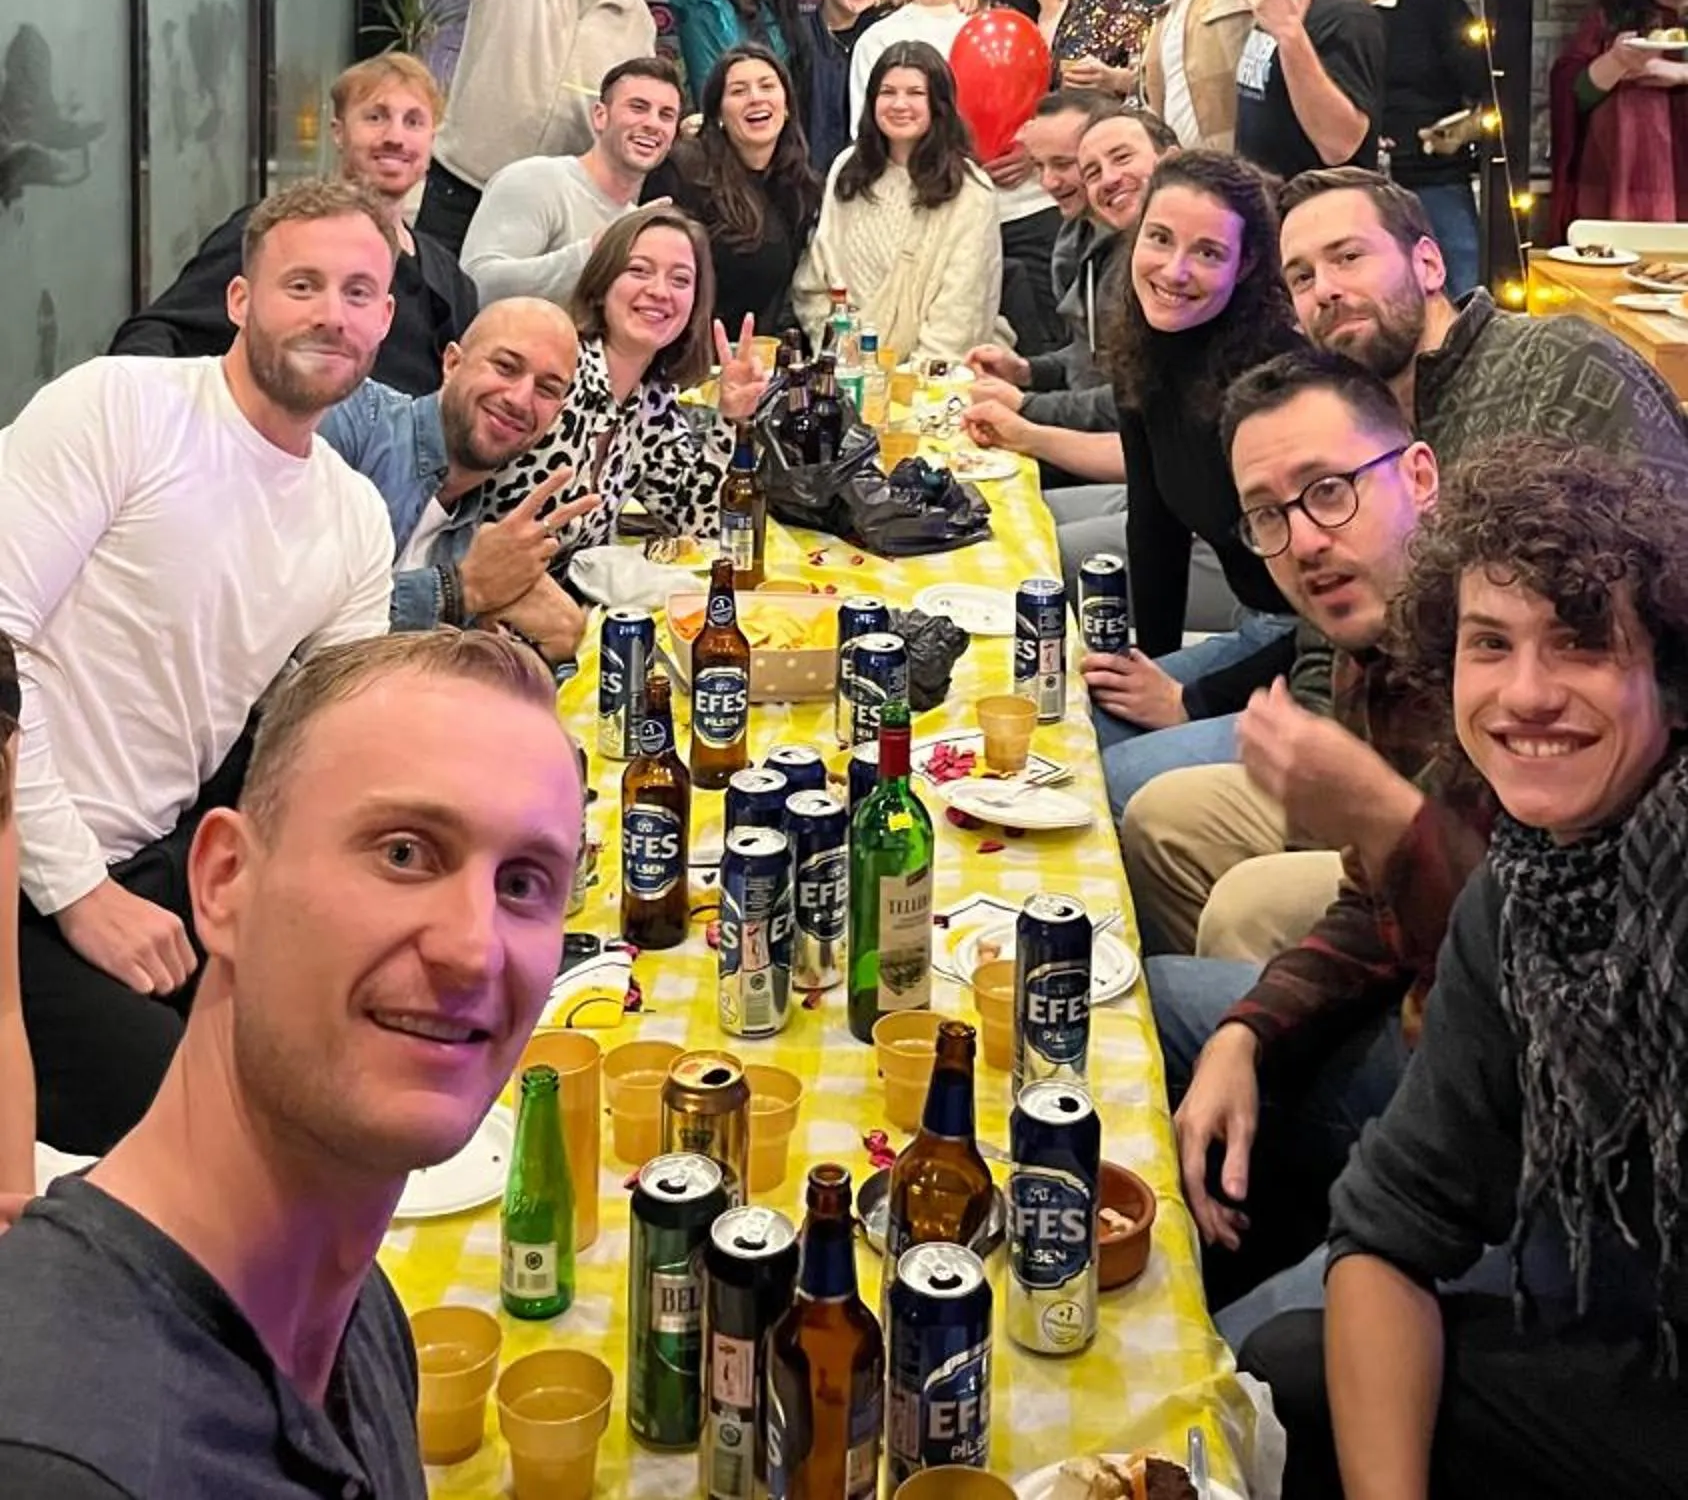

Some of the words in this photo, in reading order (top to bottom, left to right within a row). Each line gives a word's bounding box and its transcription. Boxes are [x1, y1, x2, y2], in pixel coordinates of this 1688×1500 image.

[1083, 613, 1127, 634] EFES
[1015, 638, 1037, 661] ES
[600, 671, 624, 694] ES
[696, 689, 747, 713] EFES
[857, 704, 881, 728] ES
[800, 877, 849, 908] EFE
[661, 1285, 701, 1313] BEL
